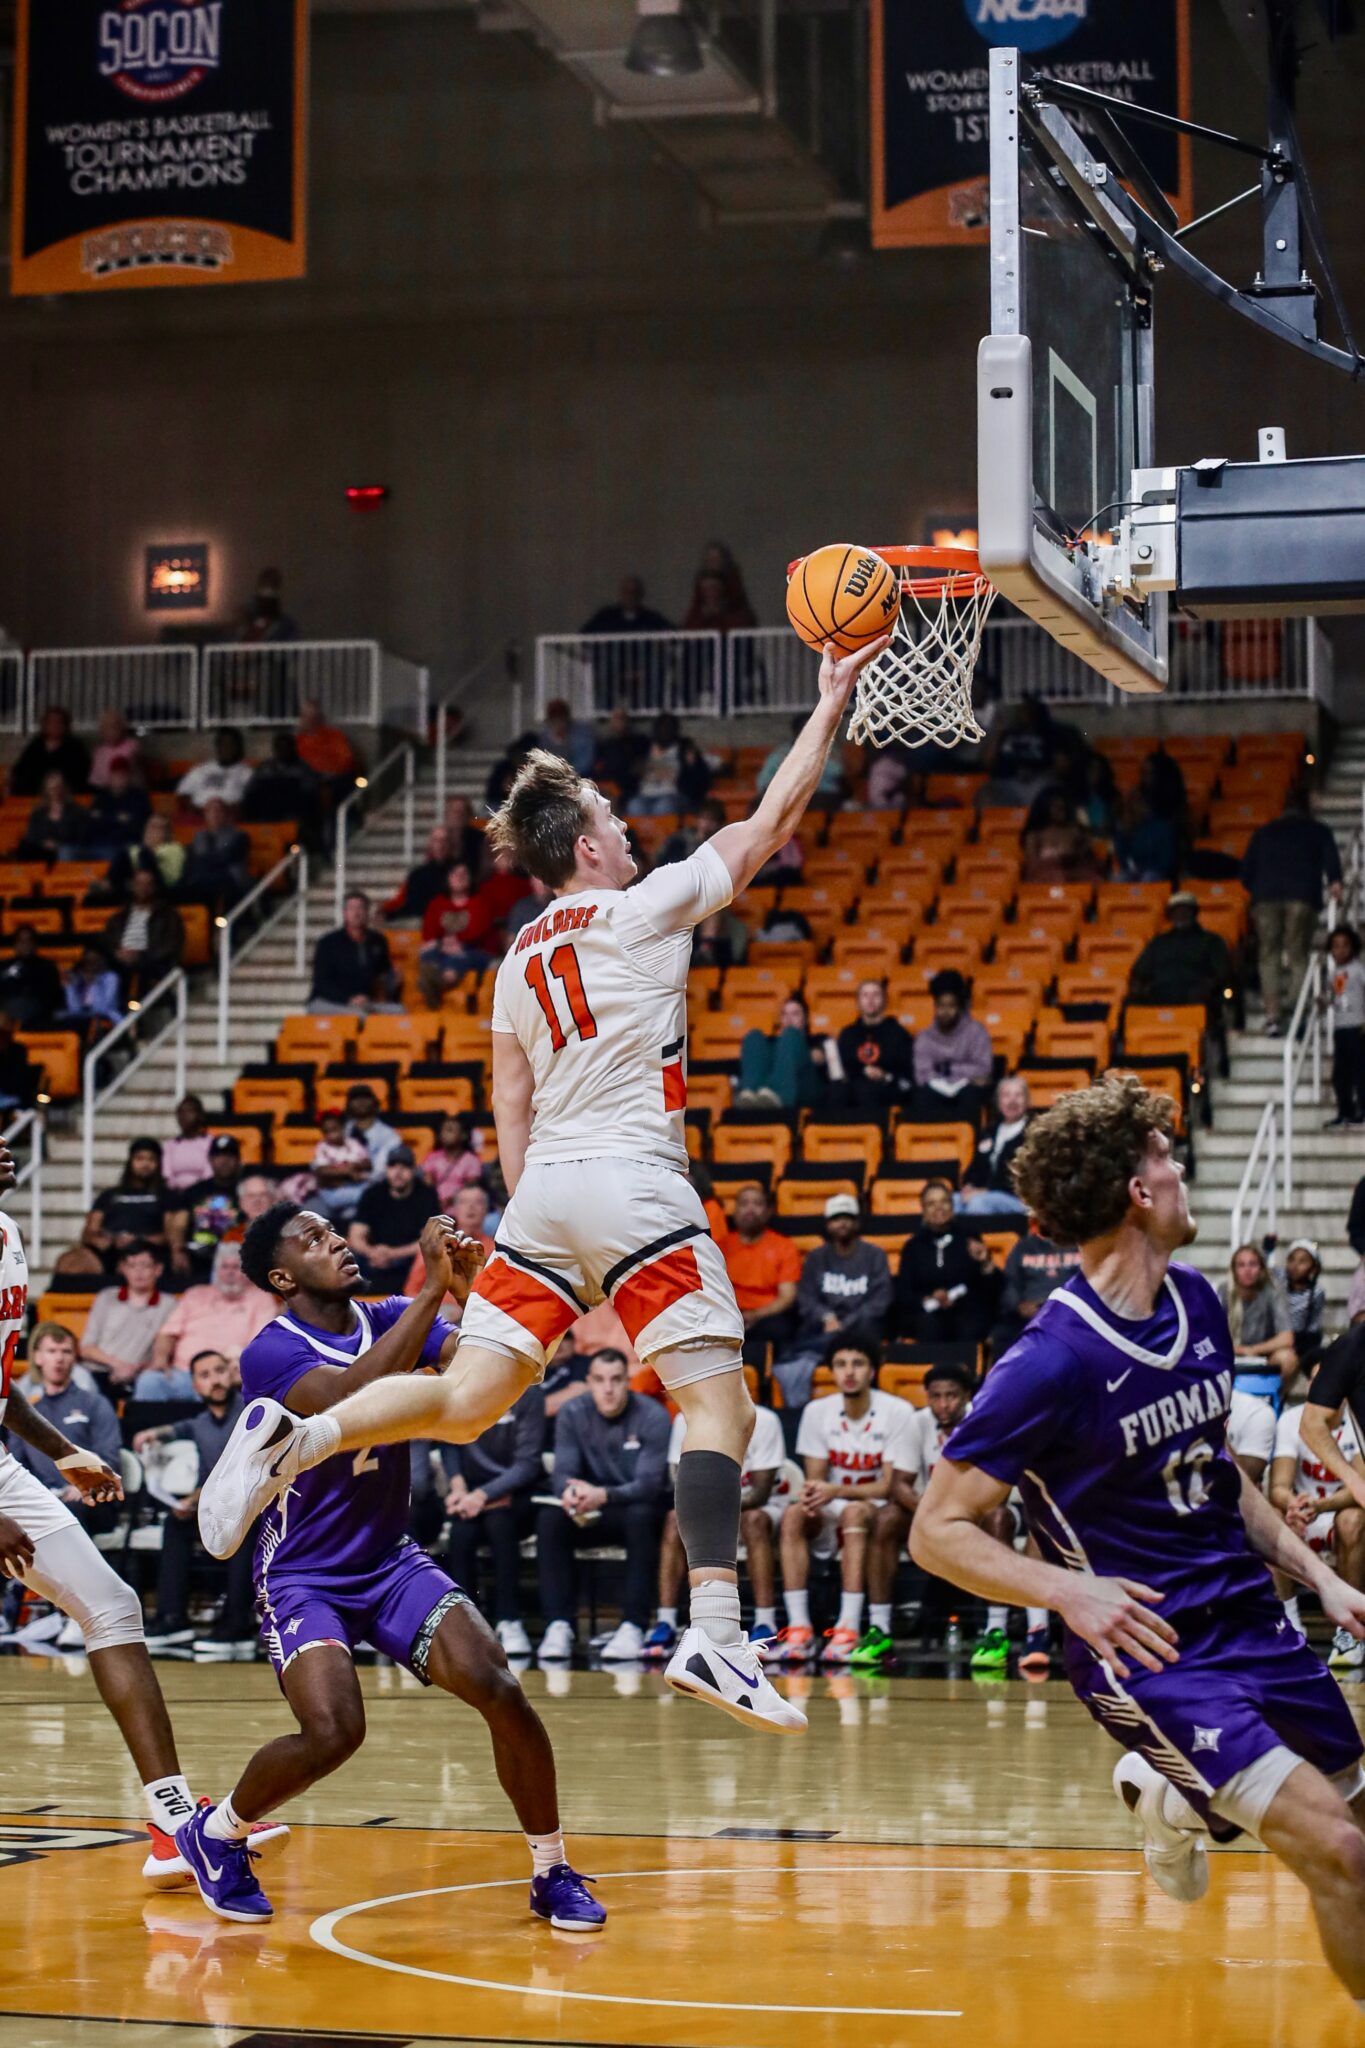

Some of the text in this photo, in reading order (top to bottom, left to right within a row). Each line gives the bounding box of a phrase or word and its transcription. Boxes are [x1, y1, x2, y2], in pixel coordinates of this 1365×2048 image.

[975, 0, 1087, 23] NCAA
[1038, 59, 1154, 84] ASKETBALL
[46, 110, 272, 144] WOMEN'S BASKETBALL
[62, 132, 257, 170] TOURNAMENT
[70, 158, 247, 195] CHAMPIONS
[524, 943, 598, 1054] 11
